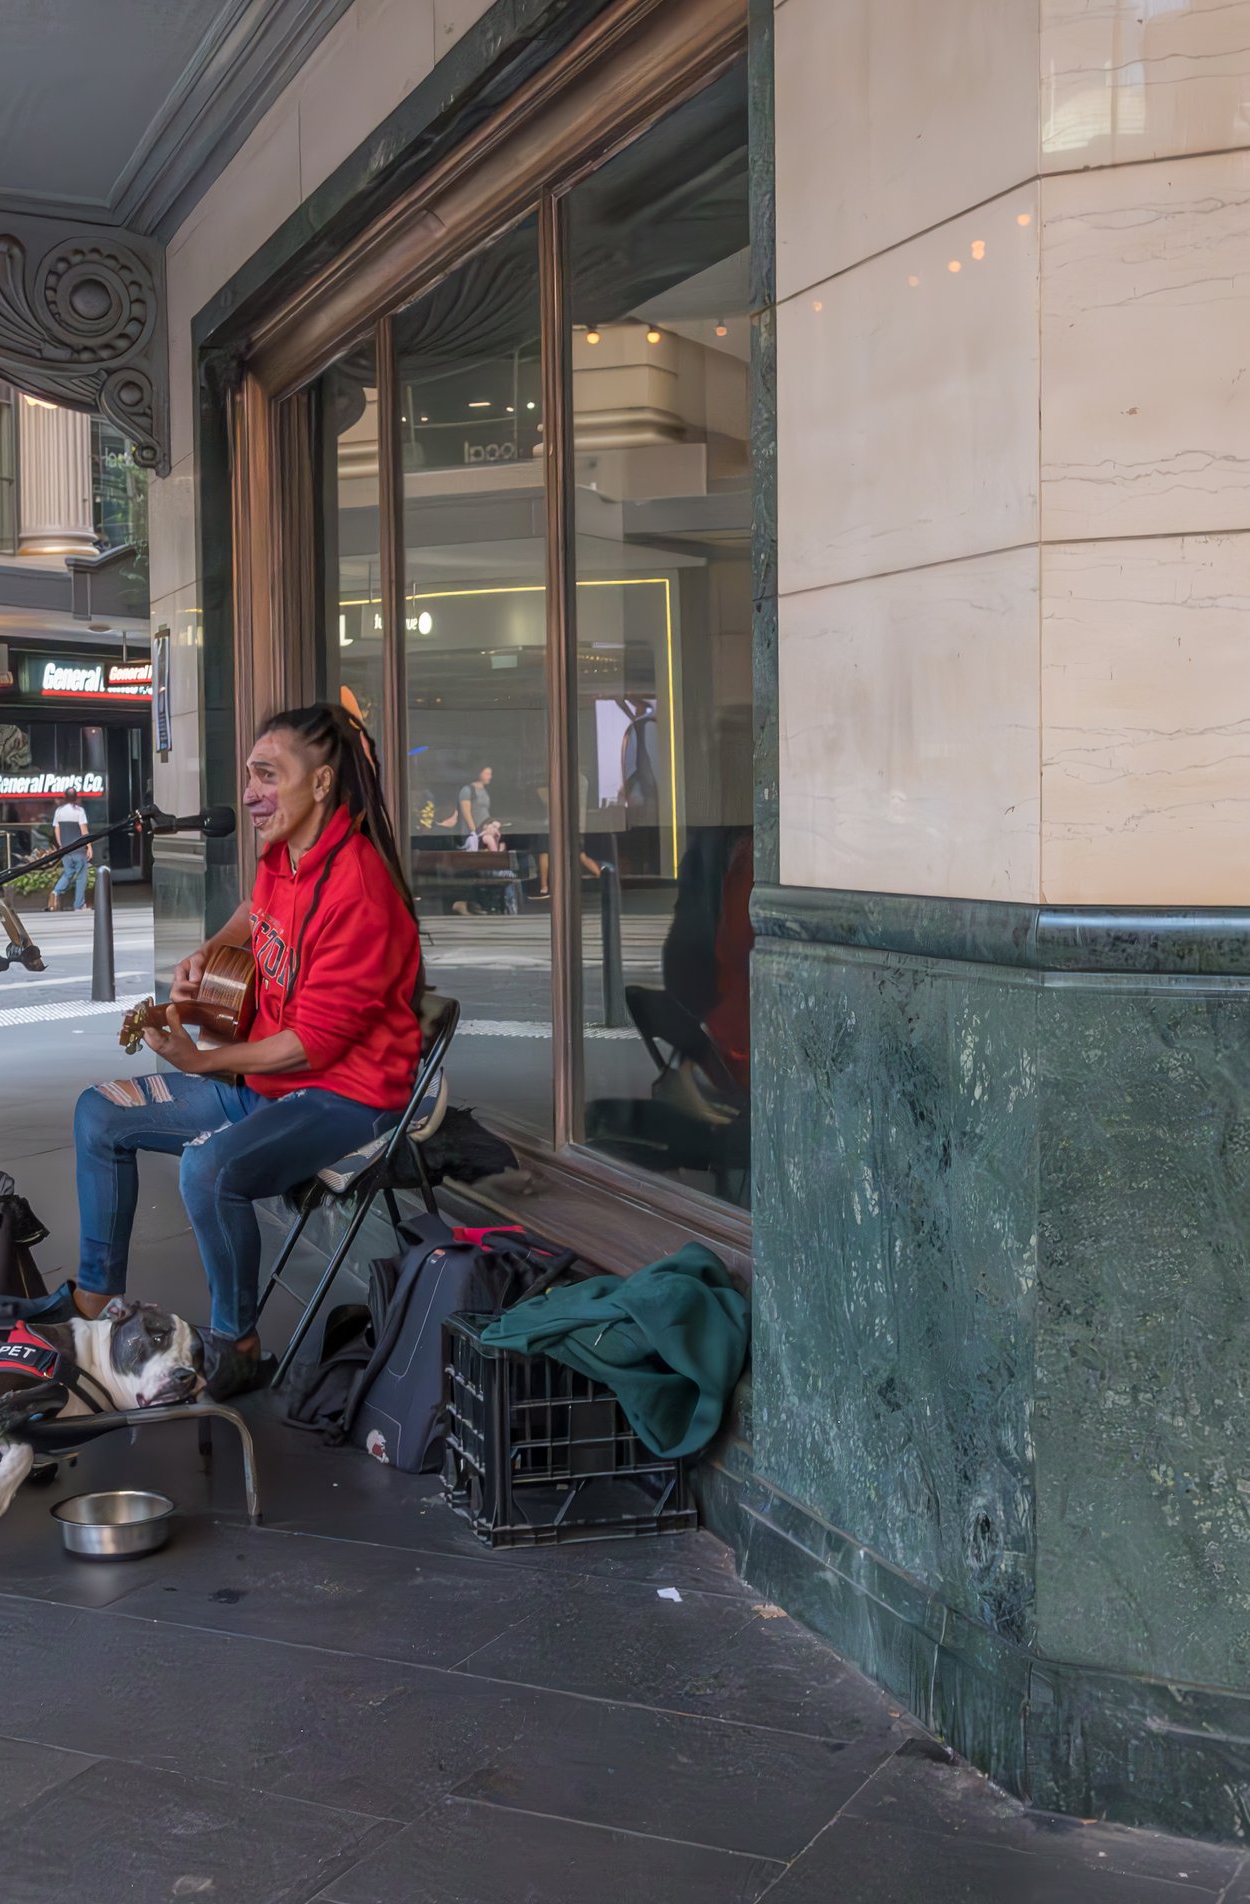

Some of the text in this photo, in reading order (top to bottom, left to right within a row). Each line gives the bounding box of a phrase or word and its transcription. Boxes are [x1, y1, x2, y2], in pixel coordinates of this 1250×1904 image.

[42, 662, 102, 692] General
[109, 665, 148, 681] General
[43, 773, 82, 793] Pants
[82, 773, 104, 792] Co.
